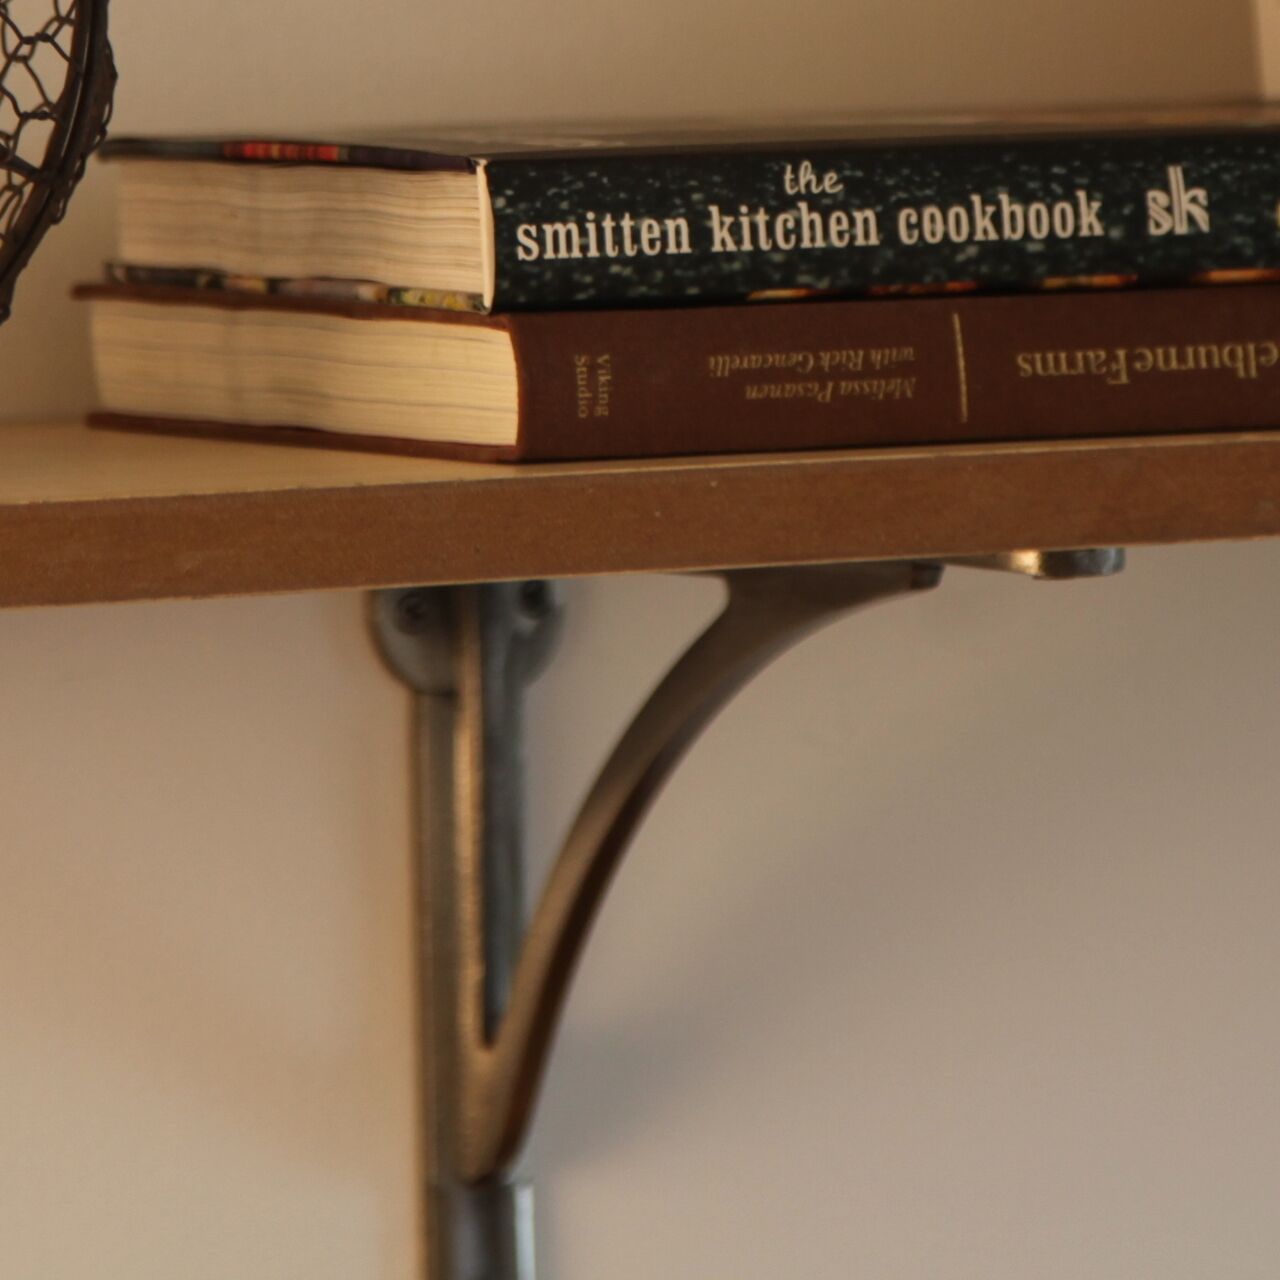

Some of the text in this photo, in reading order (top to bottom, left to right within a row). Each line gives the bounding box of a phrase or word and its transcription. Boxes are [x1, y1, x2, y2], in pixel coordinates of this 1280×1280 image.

[783, 160, 845, 197] the
[1146, 166, 1211, 236] sk
[516, 190, 1105, 261] smitten kitchen cookbook
[593, 354, 612, 417] Viking
[708, 346, 916, 377] with Rick Gencarelli
[840, 375, 916, 400] Melissa
